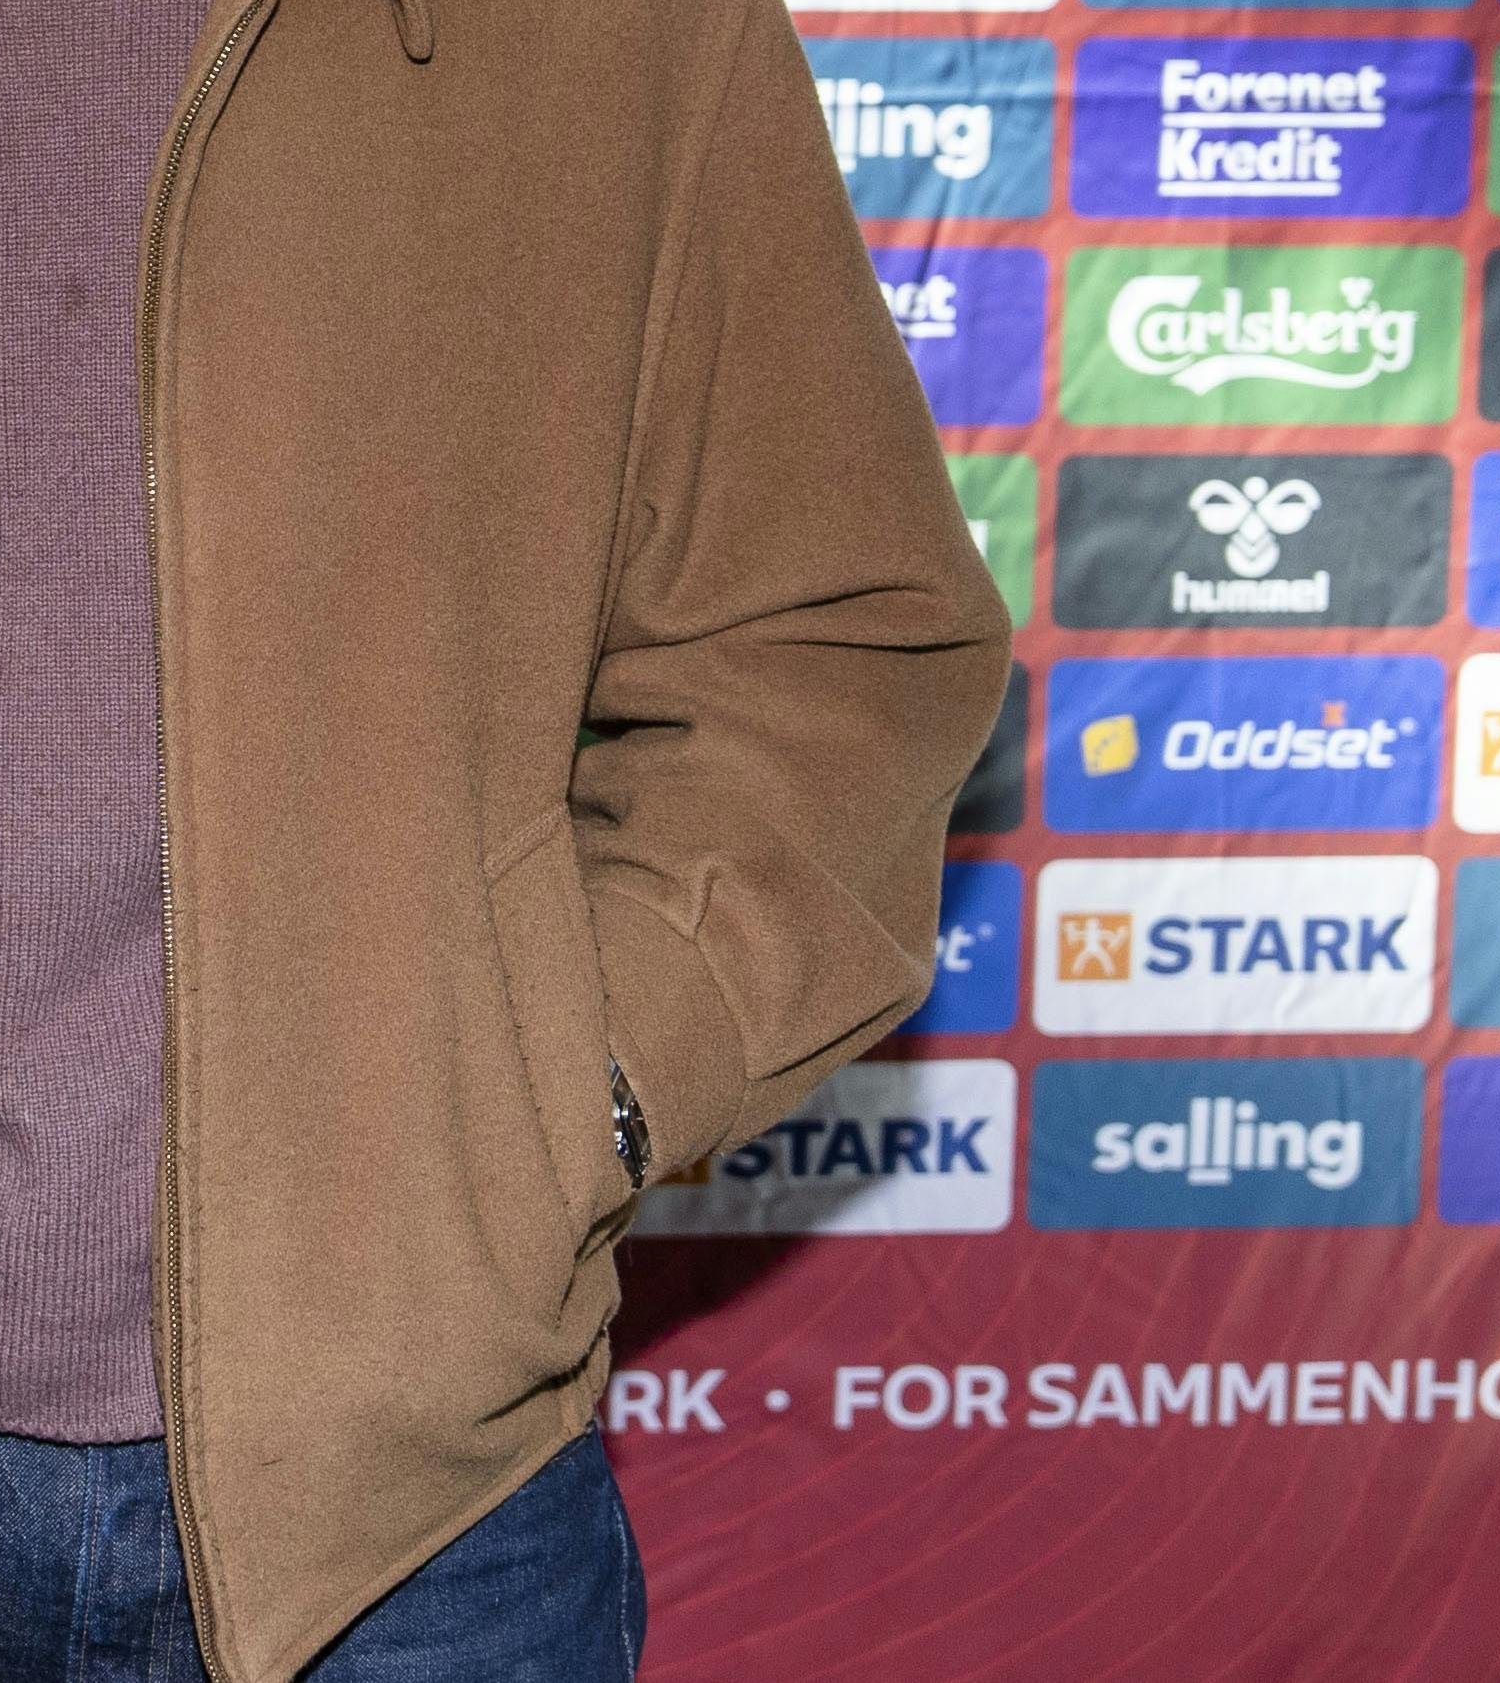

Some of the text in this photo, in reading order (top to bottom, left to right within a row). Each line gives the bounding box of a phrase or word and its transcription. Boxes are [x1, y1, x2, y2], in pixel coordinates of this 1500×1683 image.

[1160, 57, 1387, 112] Forenet
[1157, 127, 1340, 182] Kredit
[1107, 274, 1416, 396] Carlsberg
[1171, 570, 1330, 613] hummel
[1143, 915, 1406, 978] STARK
[1093, 1096, 1363, 1189] salling
[833, 1363, 1008, 1429] FOR
